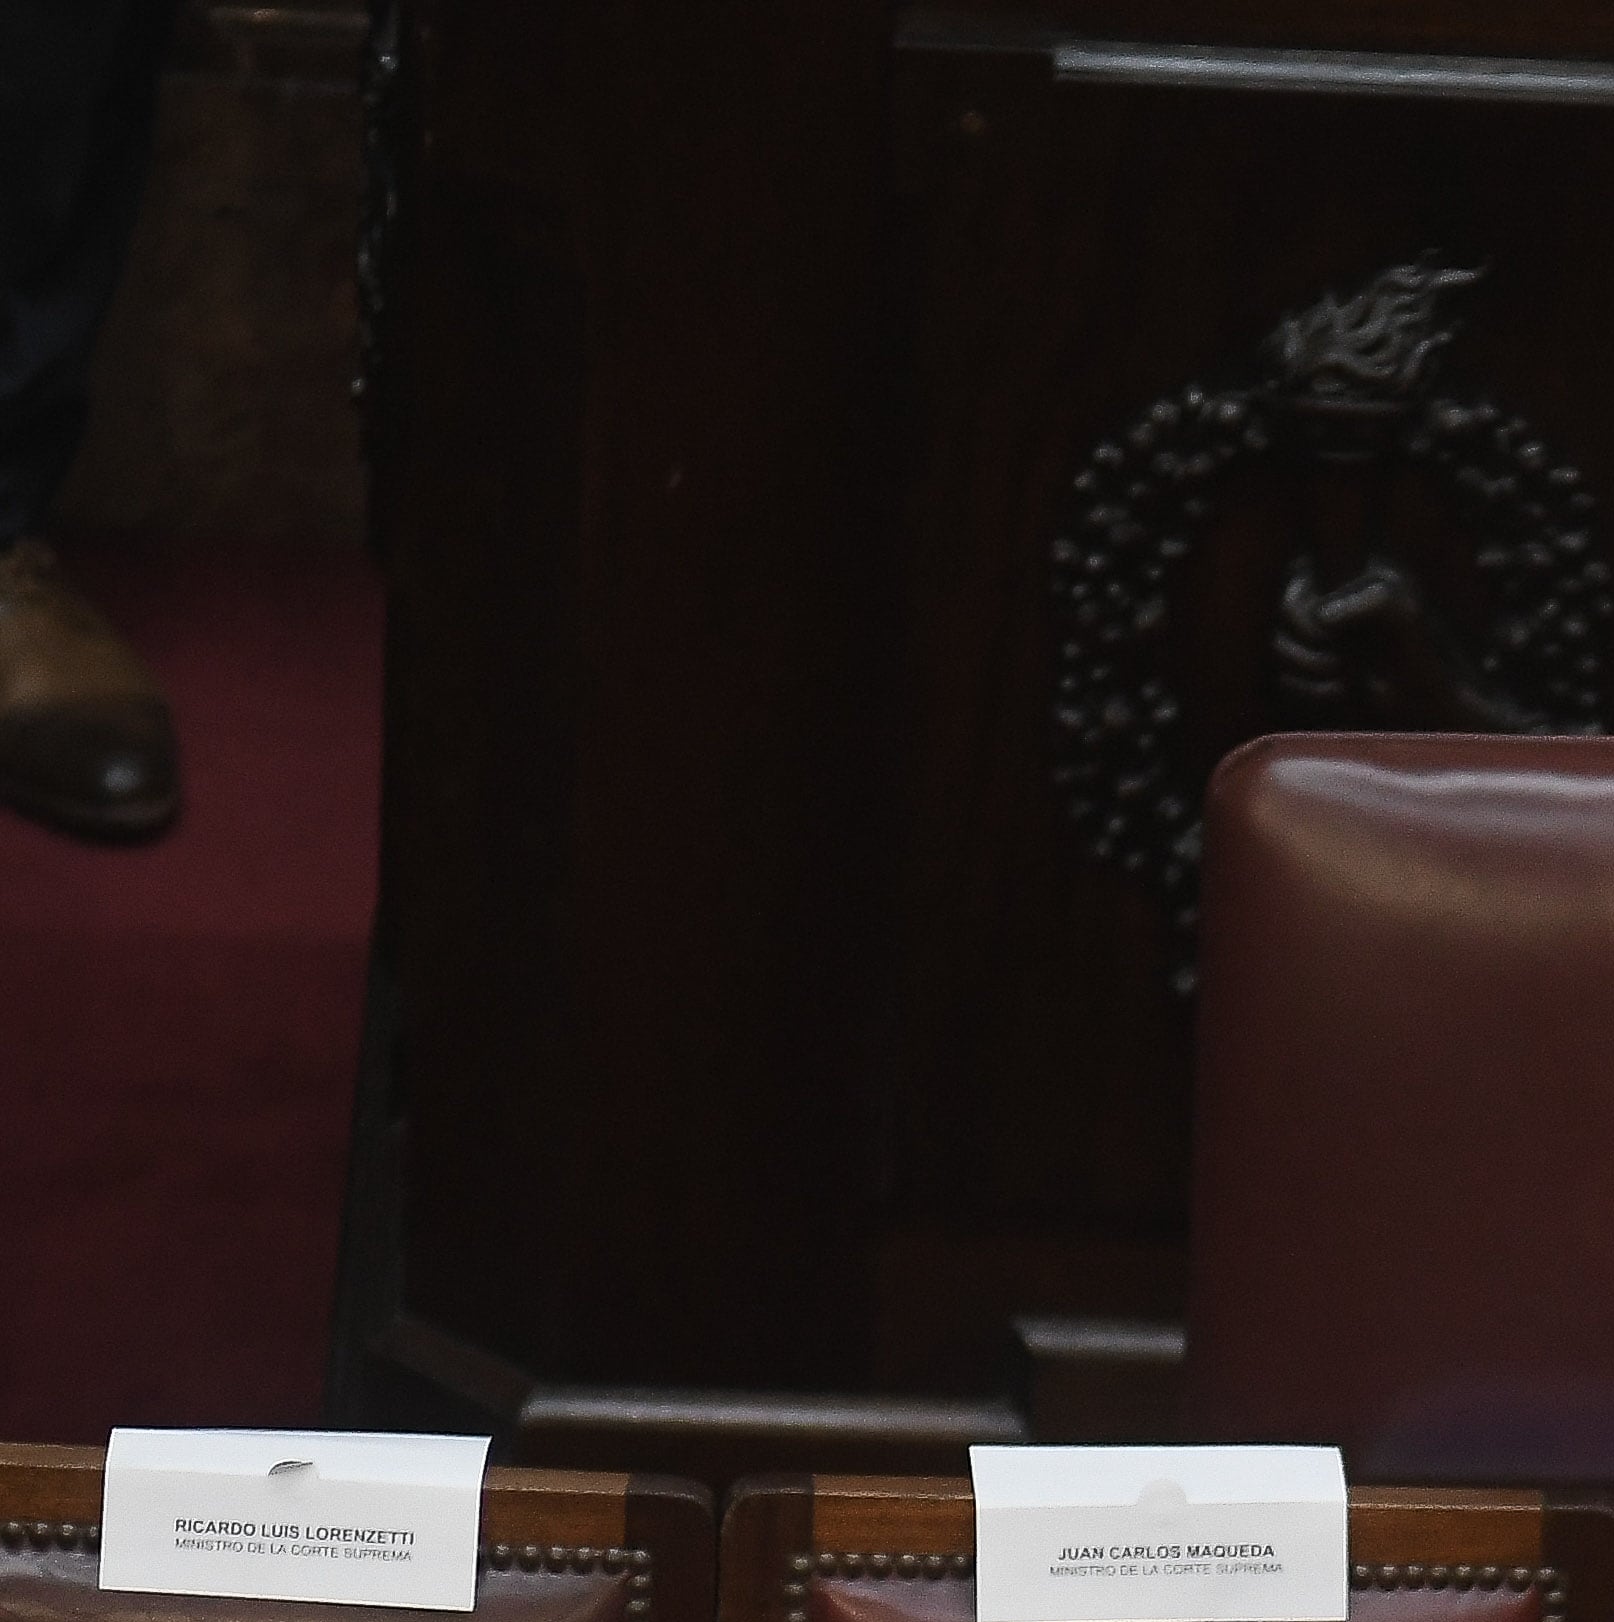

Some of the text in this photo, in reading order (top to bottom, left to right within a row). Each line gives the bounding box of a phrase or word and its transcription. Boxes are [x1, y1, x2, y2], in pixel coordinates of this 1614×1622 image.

[175, 1519, 415, 1546] RICARDO LUIS LORENZETTI
[175, 1538, 412, 1562] MINISTRO DE LA CORTE SUPREMA
[1058, 1544, 1275, 1561] JUAN CARLOS MAQUEDA
[1049, 1562, 1283, 1577] MINISTRO DE LA CORTE SUPREMA
